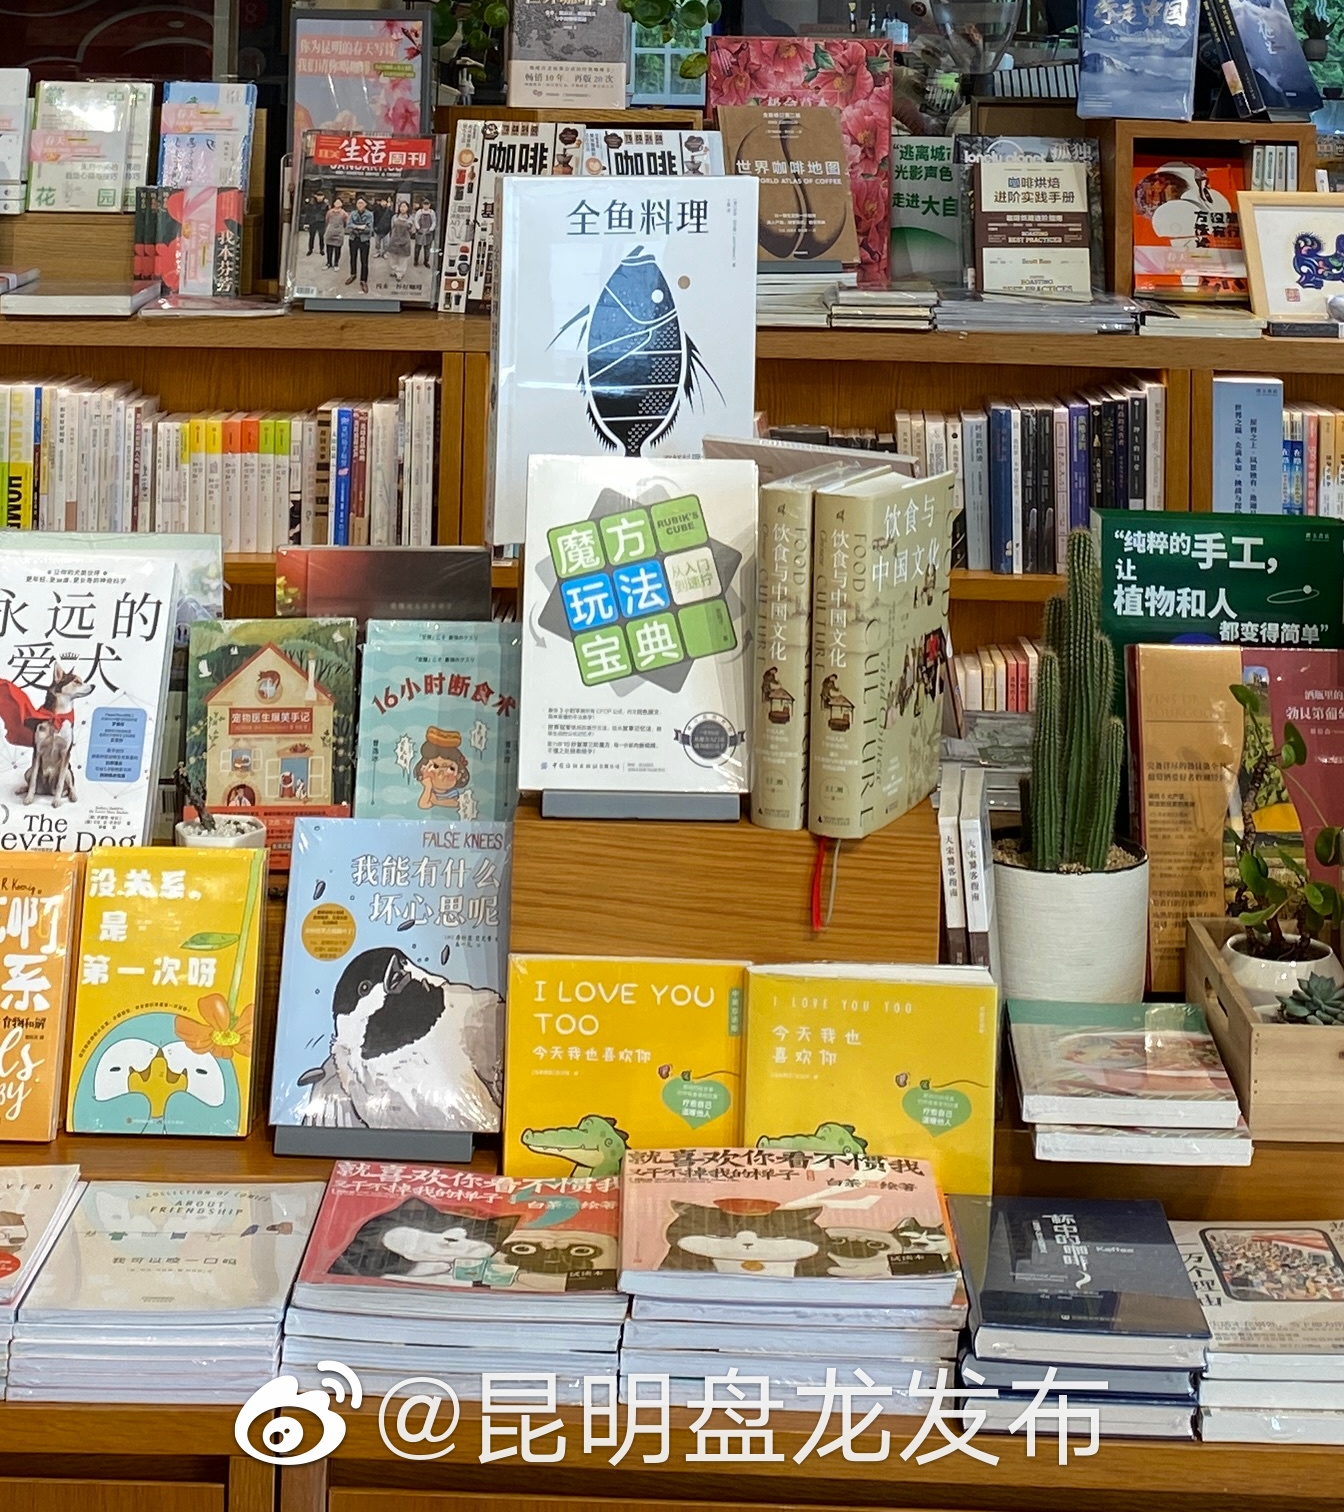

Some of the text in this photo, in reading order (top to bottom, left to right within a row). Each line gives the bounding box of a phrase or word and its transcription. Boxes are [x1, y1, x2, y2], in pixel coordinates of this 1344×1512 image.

[736, 159, 842, 176] 世界咖啡地图
[993, 190, 1076, 205] 进阶实践手册
[566, 198, 710, 236] 全鱼料理
[557, 516, 657, 577] 魔方
[1114, 558, 1138, 582] 让
[565, 567, 666, 626] 玩法
[1113, 584, 1238, 620] 植物和人
[581, 622, 680, 681] 宝典
[6, 641, 123, 694] 爱犬
[23, 813, 68, 833] The
[75, 831, 137, 850] Dog
[422, 831, 504, 850] FALSE KNEES
[351, 854, 501, 889] 我能有什么
[369, 893, 499, 927] 坏心思呢
[98, 910, 129, 942] 是
[81, 953, 217, 989] 第一次呀
[533, 980, 716, 1009] I LOVE YOU
[533, 1012, 601, 1037] TOO
[771, 1024, 863, 1047] 今天我也
[531, 1044, 652, 1065] 今天我也喜欢你
[772, 1046, 839, 1067] 喜欢你
